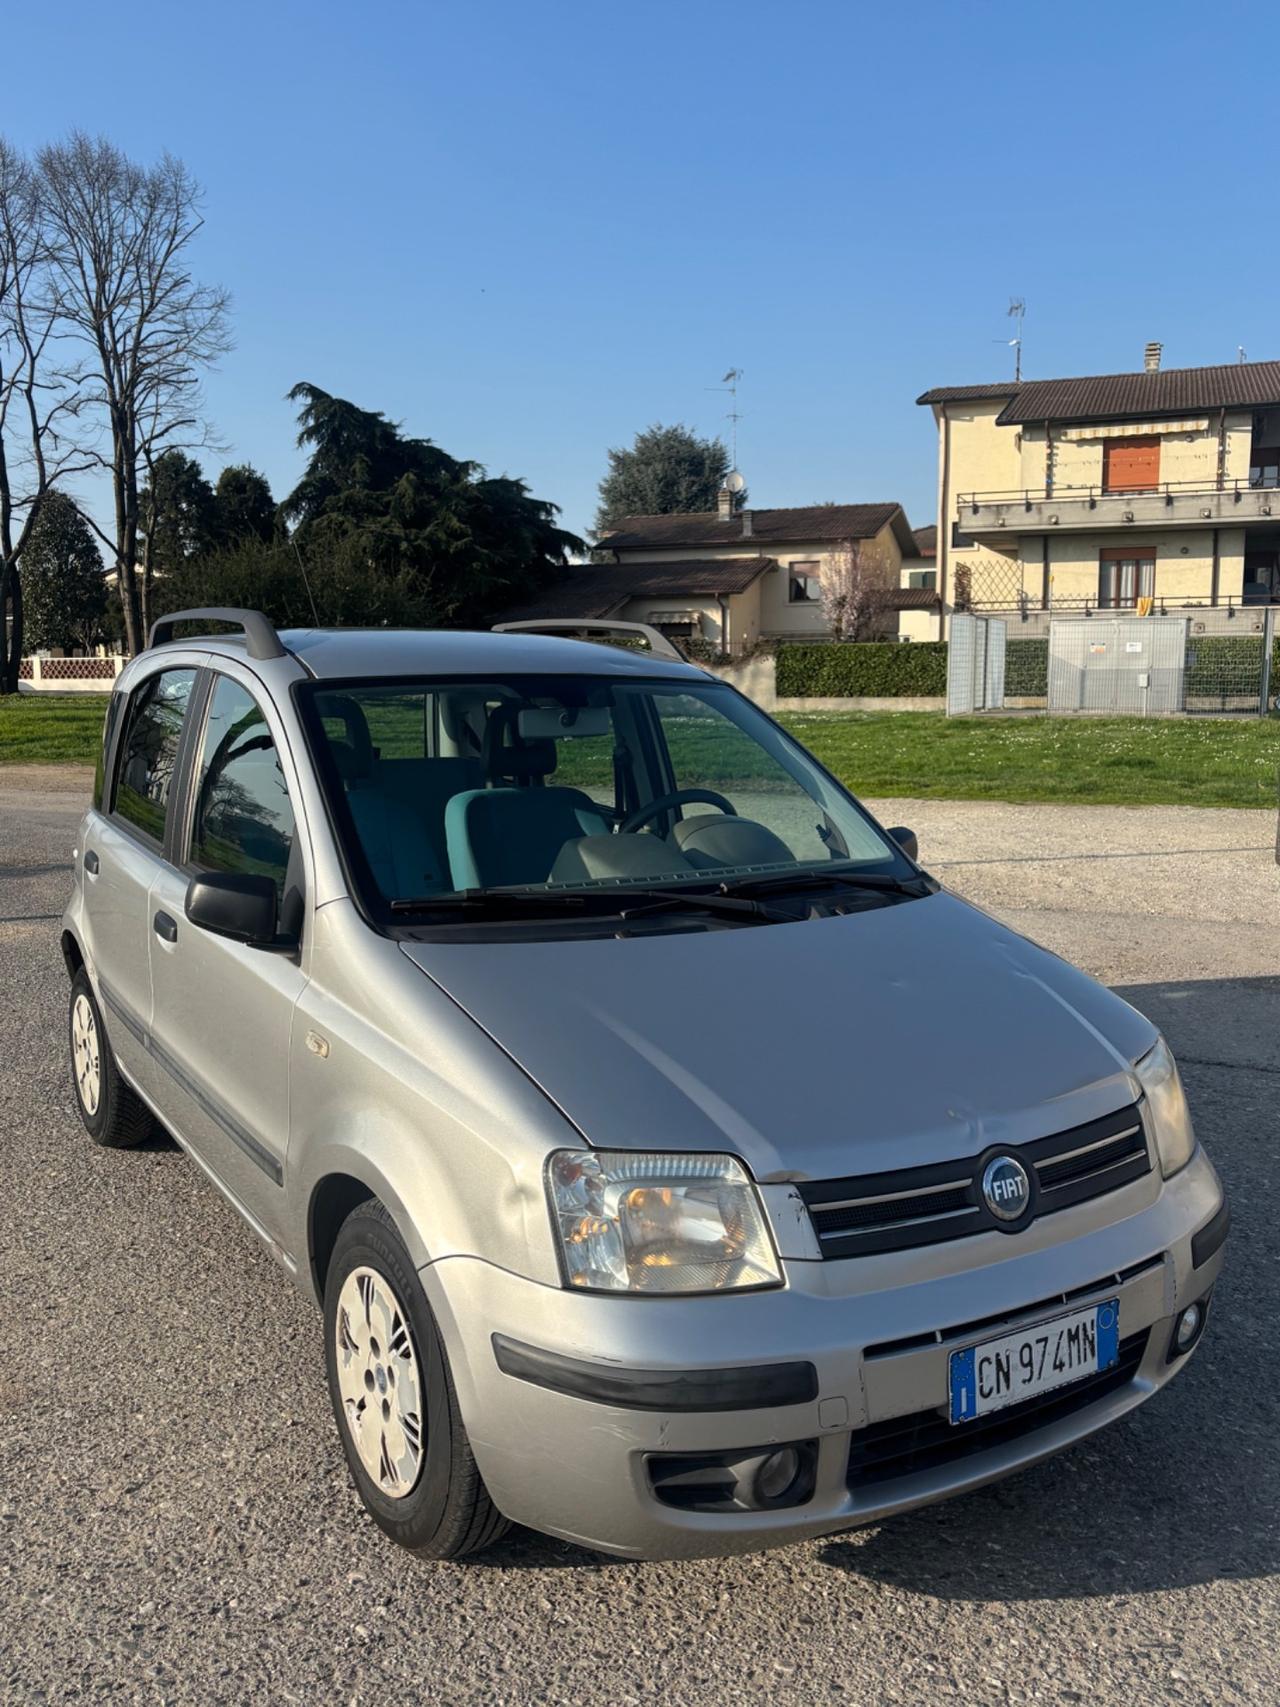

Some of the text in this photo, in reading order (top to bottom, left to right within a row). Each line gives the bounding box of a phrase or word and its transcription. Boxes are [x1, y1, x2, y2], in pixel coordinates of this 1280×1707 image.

[992, 1175, 1023, 1202] FIAT
[978, 1350, 1011, 1399] CN
[960, 1387, 967, 1413] I
